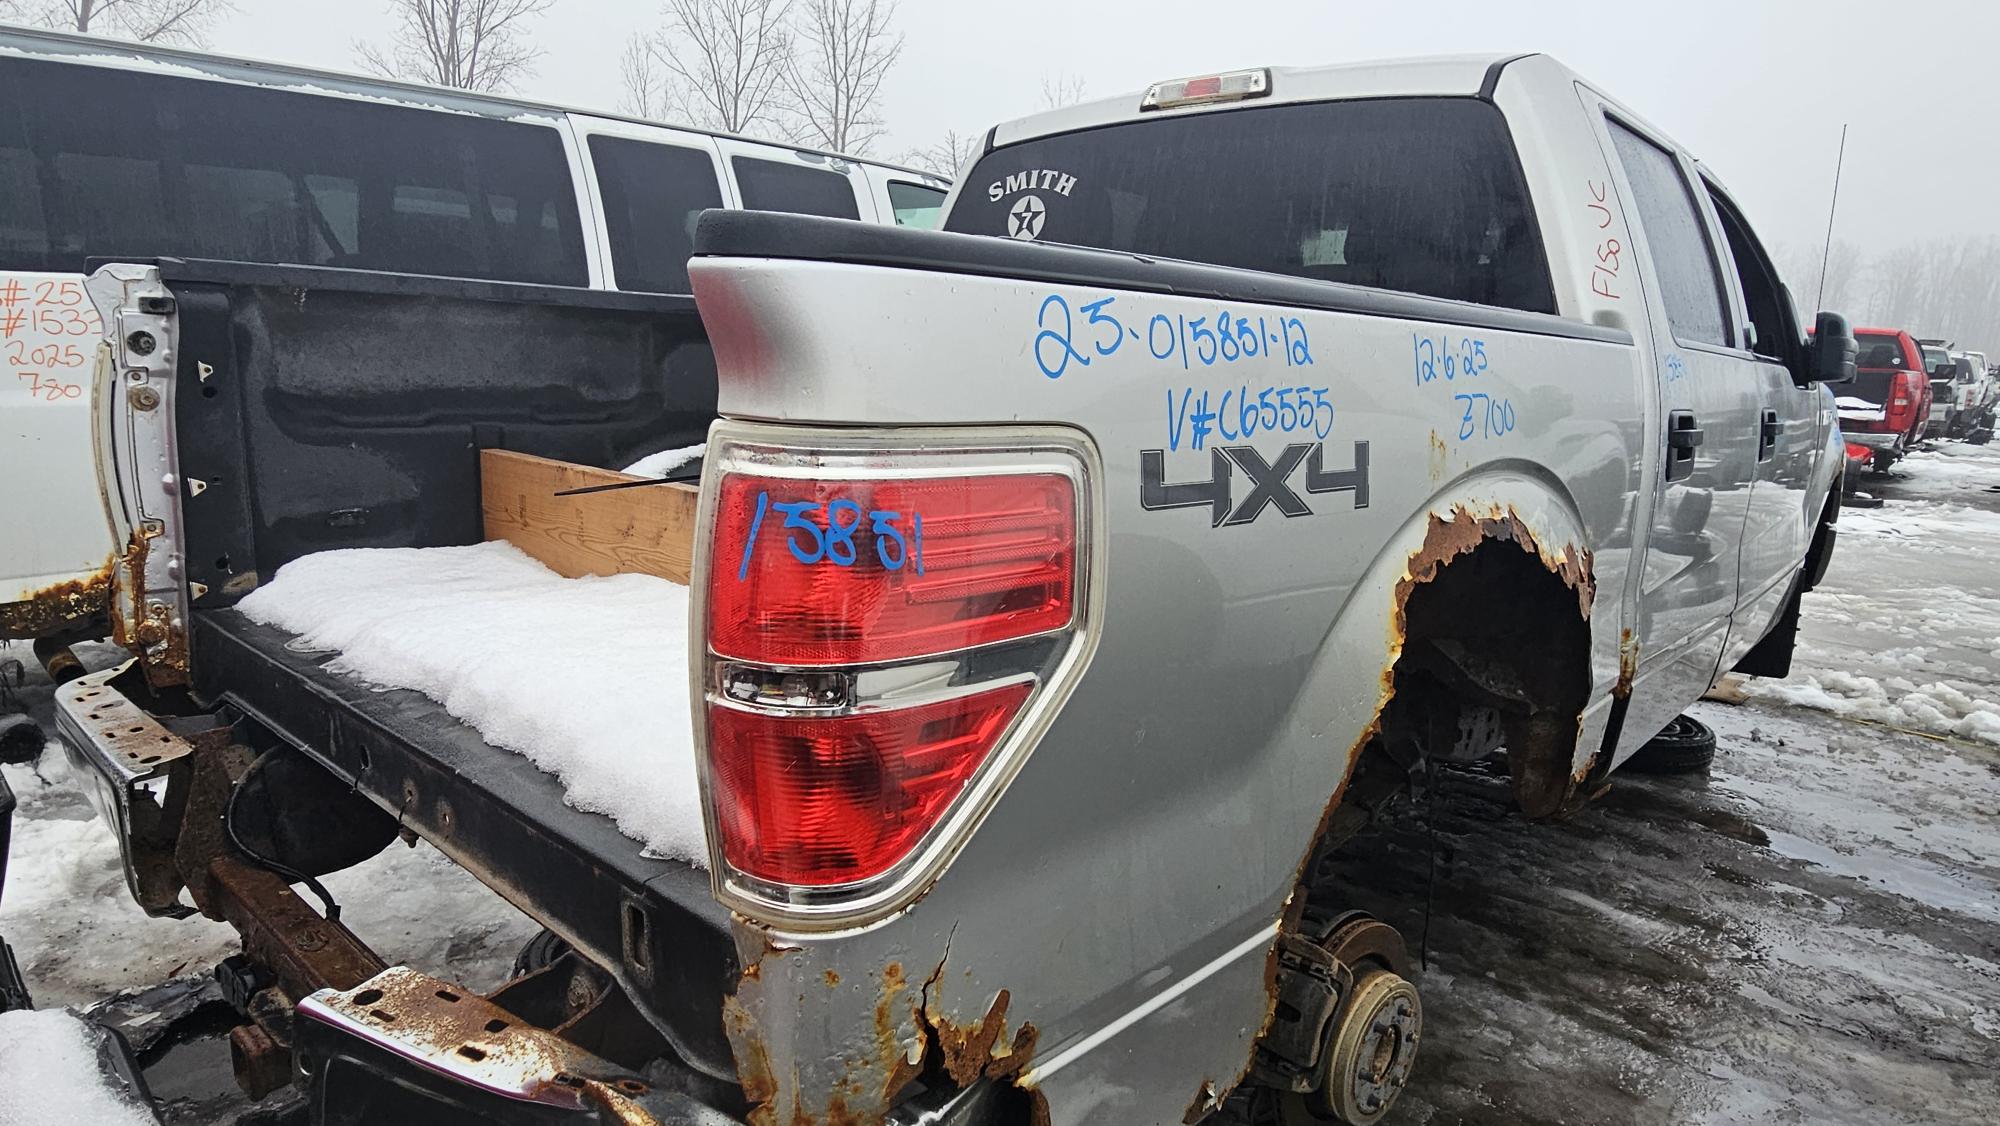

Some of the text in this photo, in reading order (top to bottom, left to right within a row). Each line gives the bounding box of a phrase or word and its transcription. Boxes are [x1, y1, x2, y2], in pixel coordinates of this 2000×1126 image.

[988, 169, 1078, 202] SMITH
[1021, 212, 1033, 229] 7
[5, 340, 84, 368] 2025
[738, 491, 924, 582] 15851
